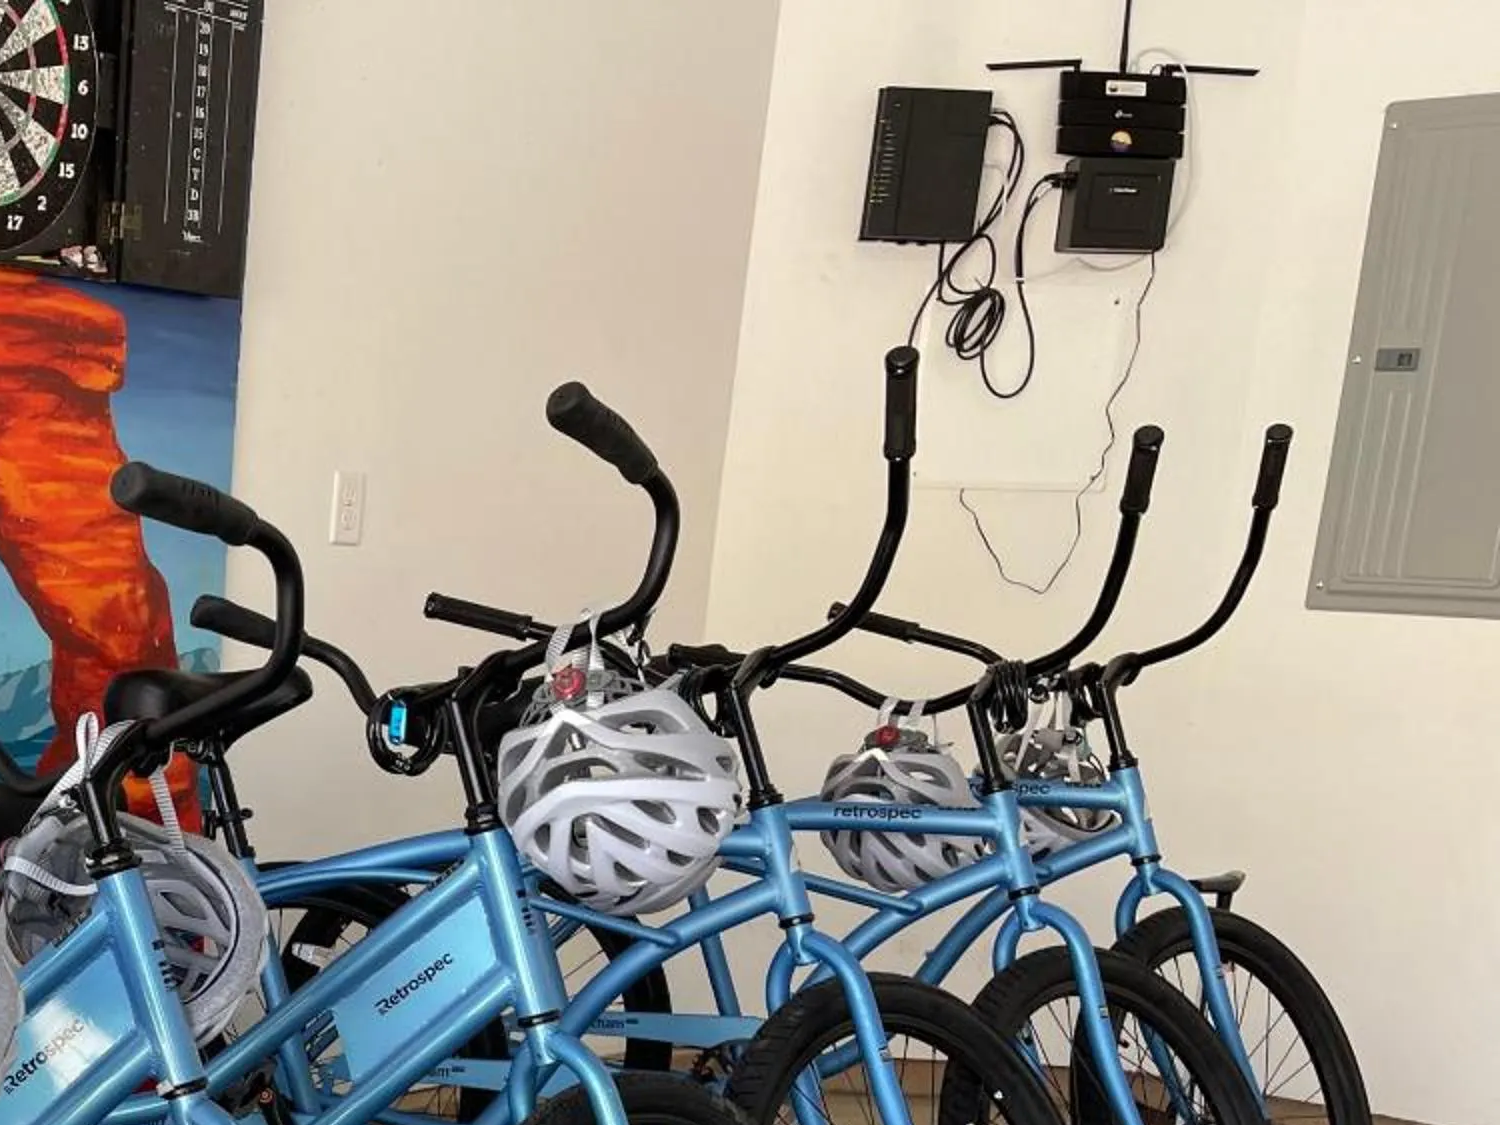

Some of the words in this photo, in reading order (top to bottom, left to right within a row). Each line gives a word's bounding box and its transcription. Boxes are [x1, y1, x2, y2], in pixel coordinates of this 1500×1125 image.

[77, 79, 89, 96] 6
[70, 122, 89, 140] 10
[193, 147, 202, 161] C
[58, 161, 75, 179] 15
[189, 187, 199, 201] D
[36, 195, 48, 212] 2
[6, 215, 25, 231] 17
[833, 804, 923, 822] retrospec
[373, 952, 454, 1017] Retrospec
[3, 1018, 85, 1096] Retrospec
